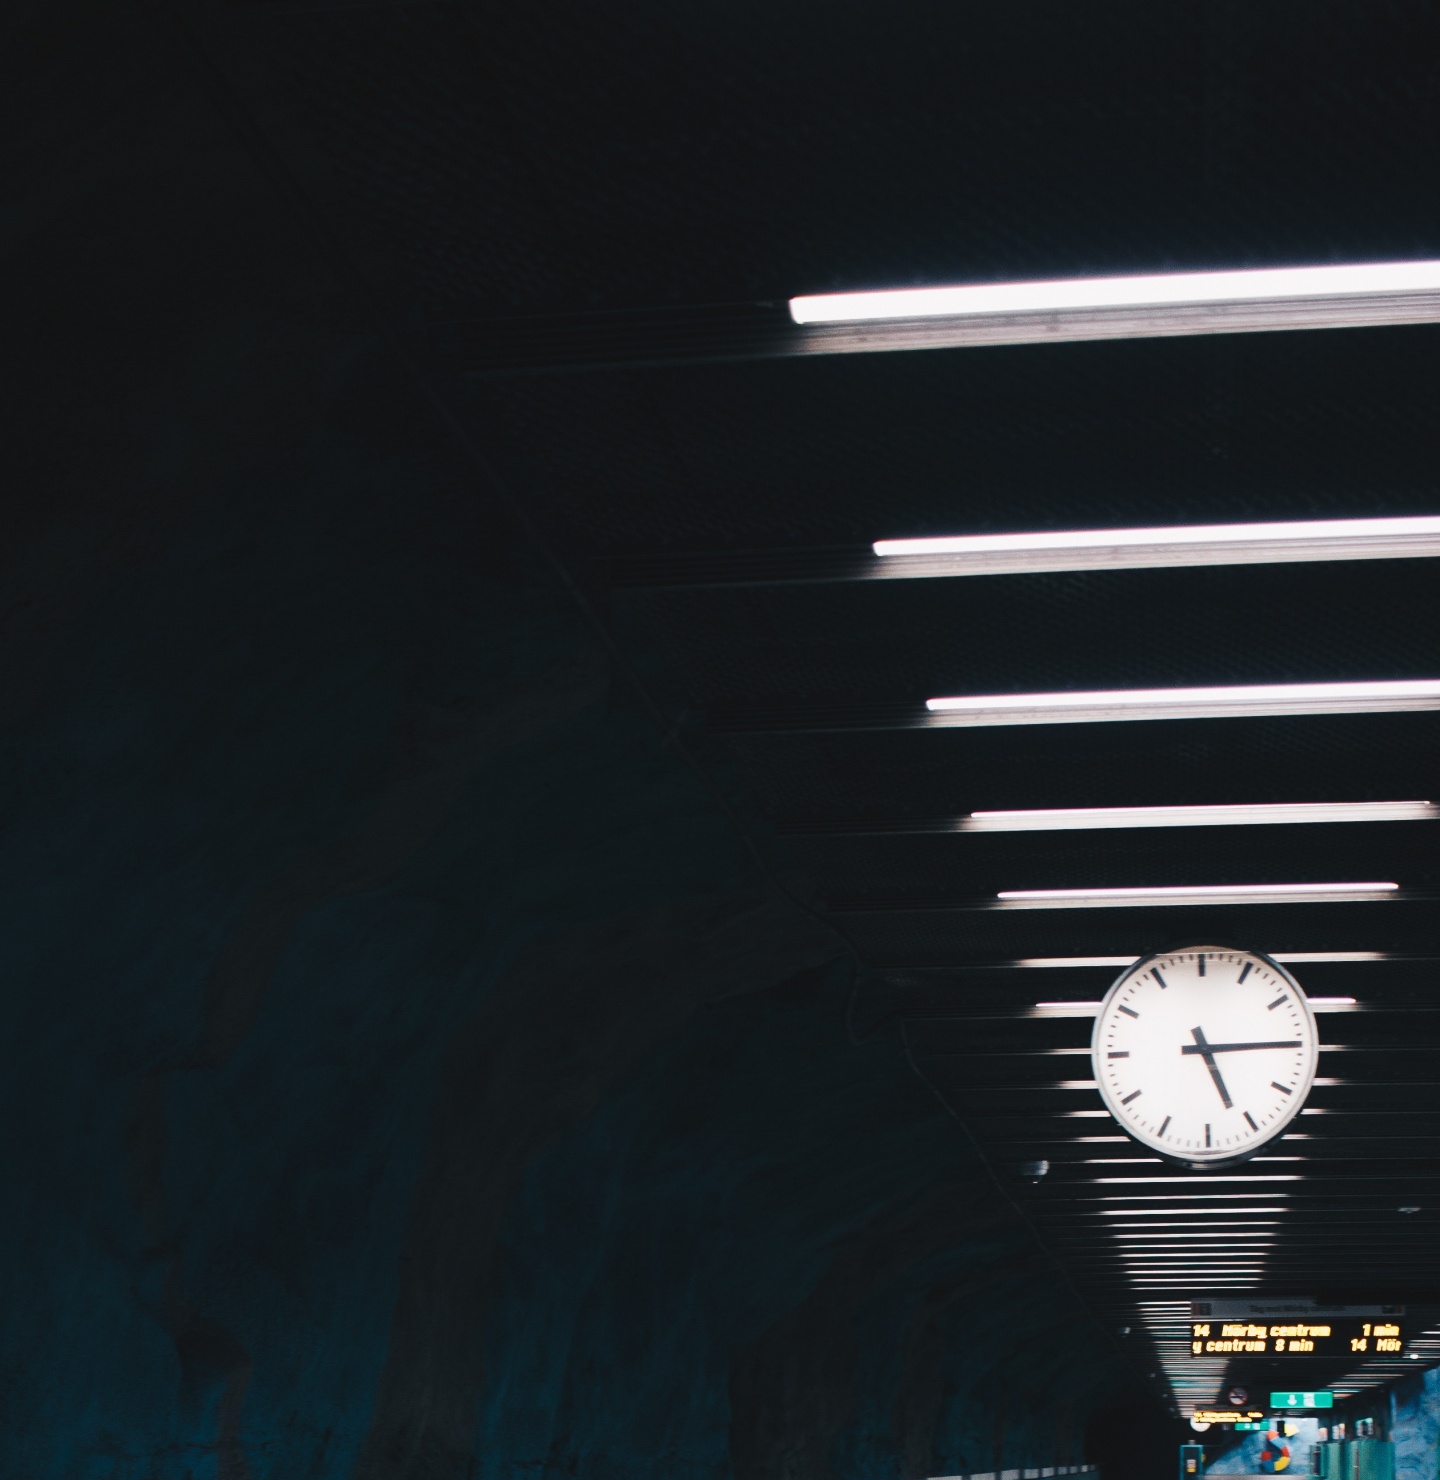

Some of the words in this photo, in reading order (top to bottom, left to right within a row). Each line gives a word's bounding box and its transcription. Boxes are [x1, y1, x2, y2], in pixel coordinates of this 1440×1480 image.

[1193, 1324, 1210, 1337] 14
[1270, 1324, 1331, 1337] centrum
[1362, 1323, 1371, 1337] 1
[1373, 1323, 1400, 1337] min
[1206, 1339, 1266, 1352] centrum
[1275, 1338, 1285, 1352] 8
[1288, 1338, 1314, 1352] min
[1351, 1338, 1367, 1352] 14
